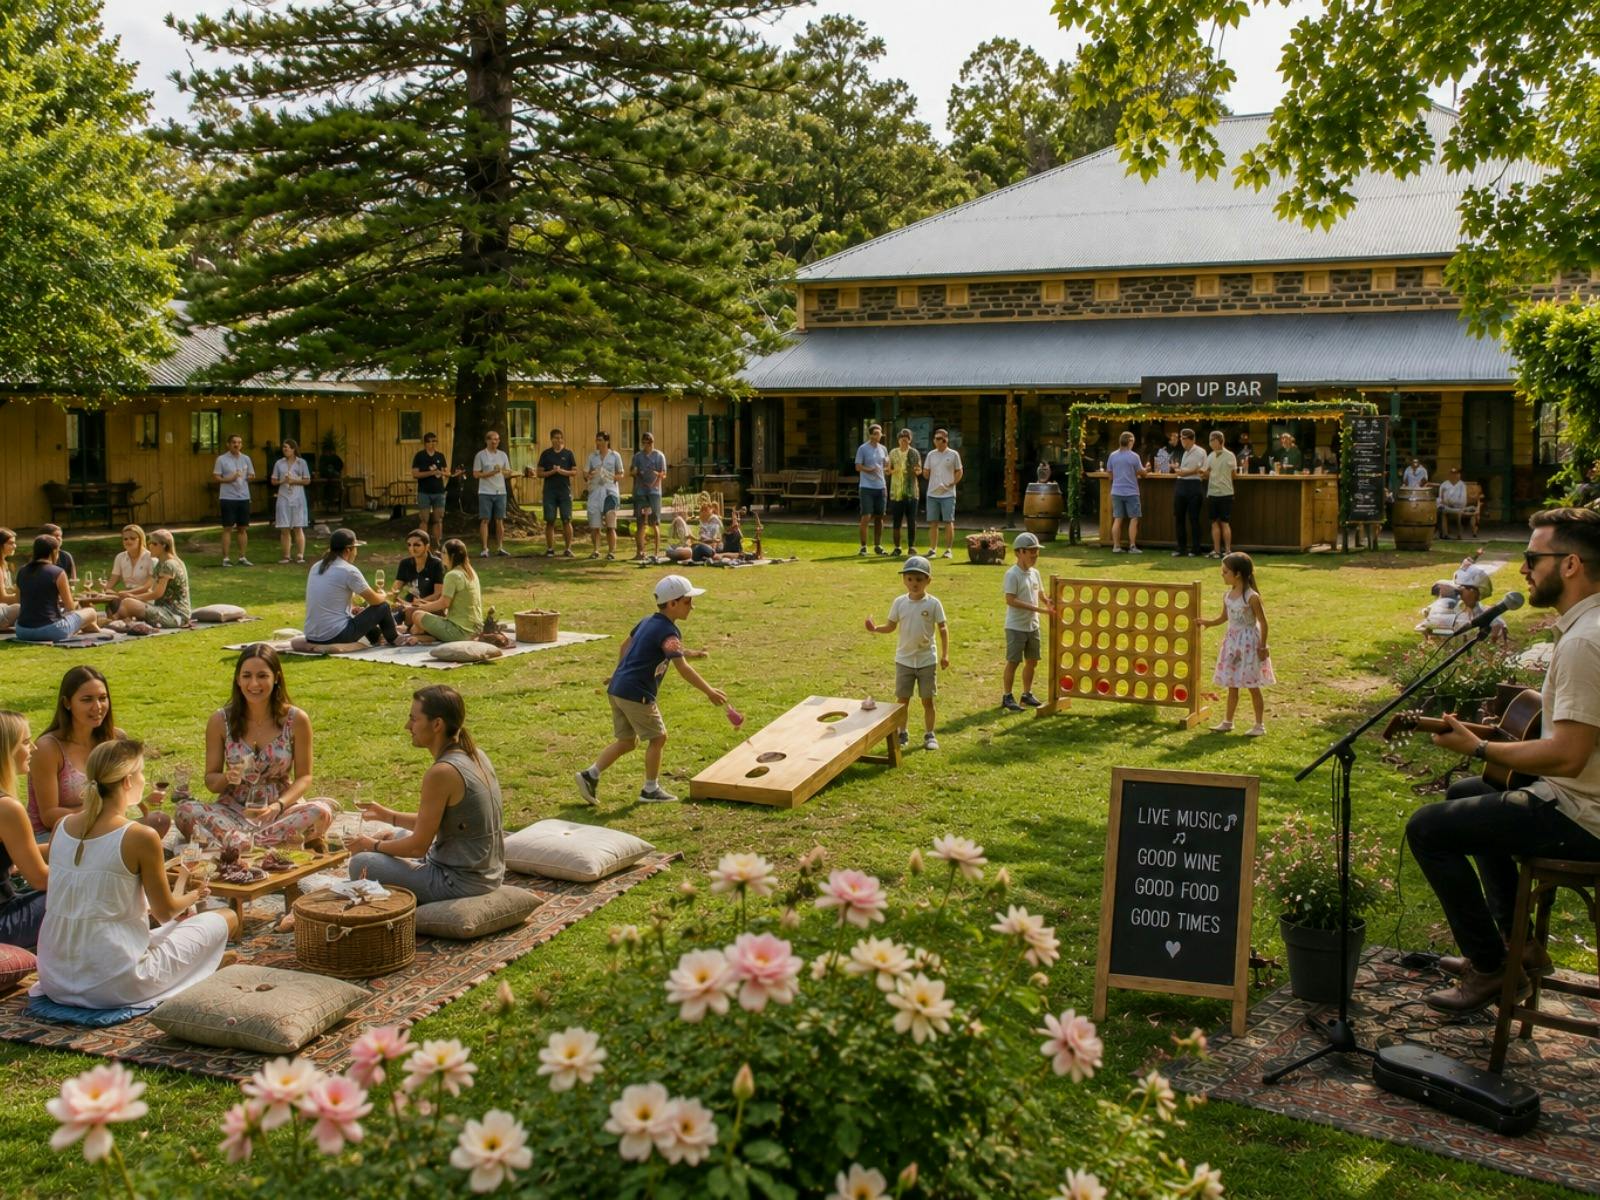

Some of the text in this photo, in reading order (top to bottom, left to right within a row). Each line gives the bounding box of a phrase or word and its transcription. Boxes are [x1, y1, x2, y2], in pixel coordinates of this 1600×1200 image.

[1156, 381, 1261, 397] POP UP BAR
[1137, 807, 1223, 830] LIVE MUSIC
[1137, 848, 1222, 872] GOOD WINE
[1134, 877, 1219, 902] GOOD FOOD
[1130, 907, 1221, 934] GOOD TIMES
